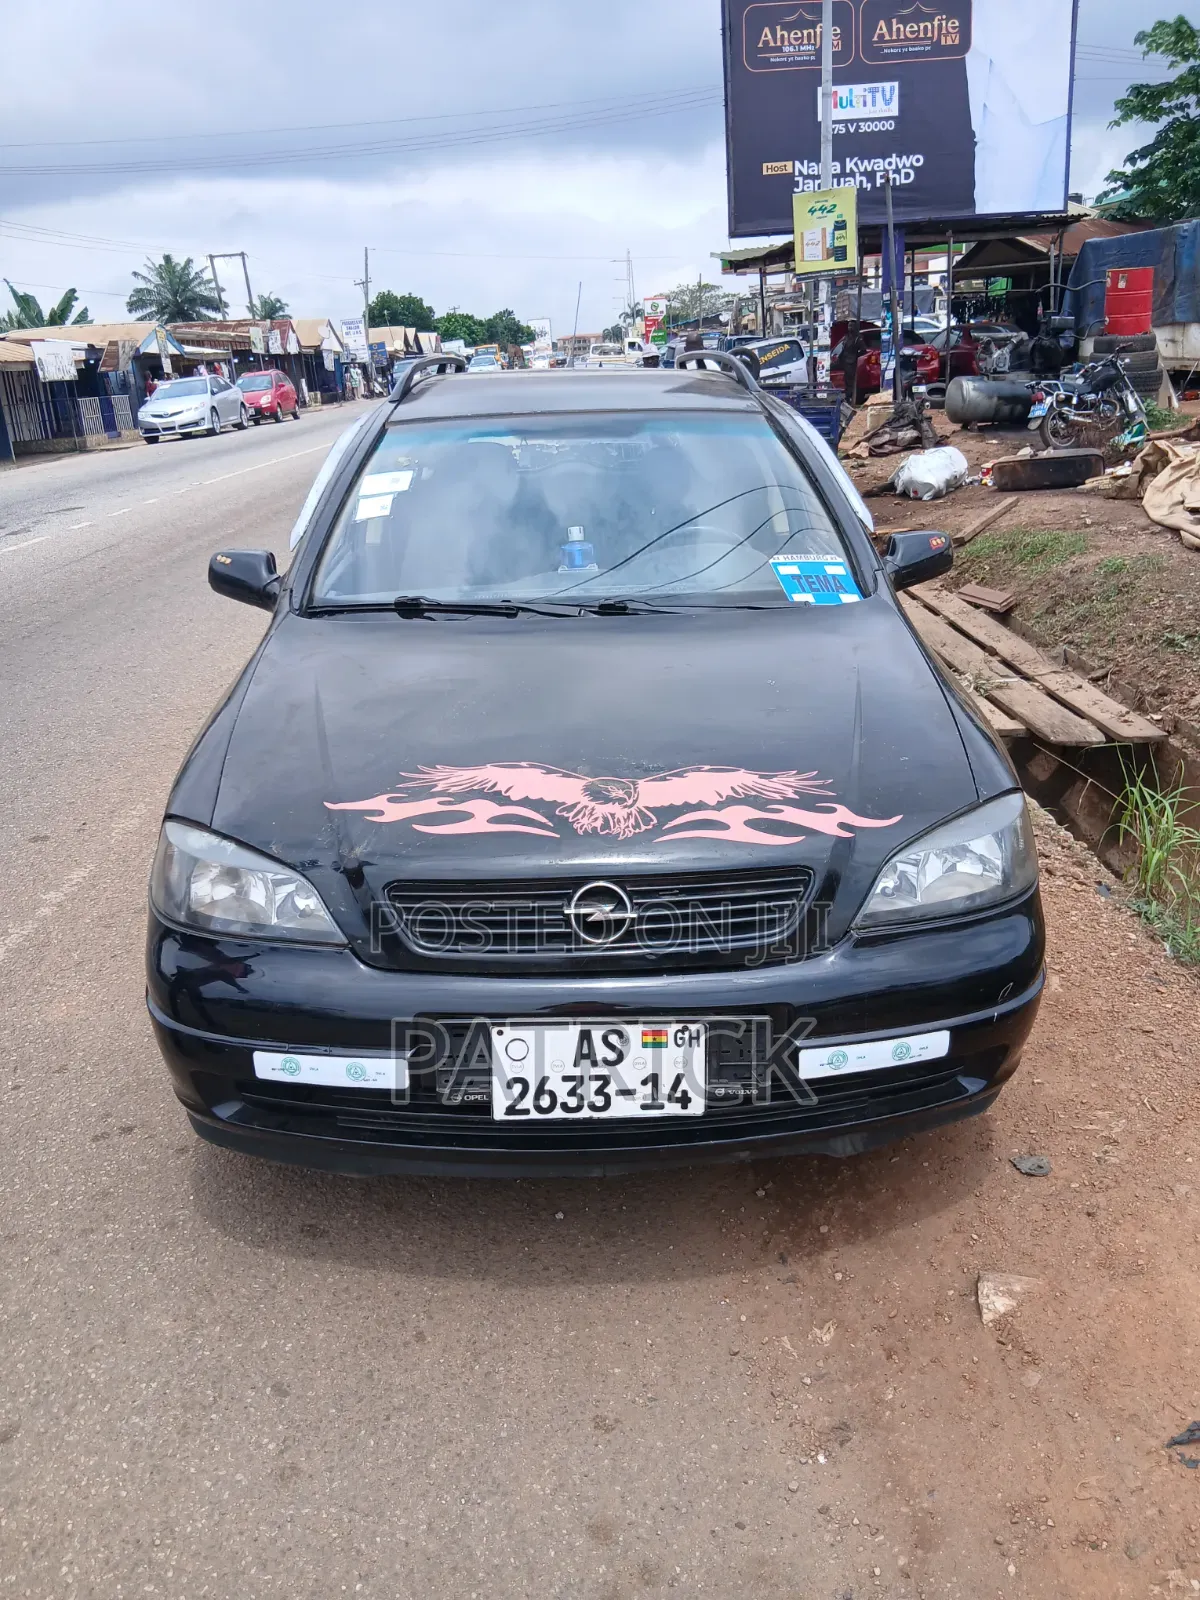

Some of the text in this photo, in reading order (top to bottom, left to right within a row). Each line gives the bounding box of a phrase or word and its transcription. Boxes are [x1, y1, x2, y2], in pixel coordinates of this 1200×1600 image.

[757, 23, 841, 48] Ahenfe
[872, 15, 959, 42] Ahenfie
[942, 34, 958, 44] TV
[848, 122, 857, 133] V
[858, 120, 895, 133] 30000
[766, 163, 788, 173] Host
[794, 153, 924, 176] Naa Kwadwo
[807, 203, 838, 217] 442
[790, 574, 849, 594] TEMA
[572, 1028, 626, 1068] AS
[673, 1028, 700, 1049] GH
[503, 1072, 692, 1116] 2633-14
